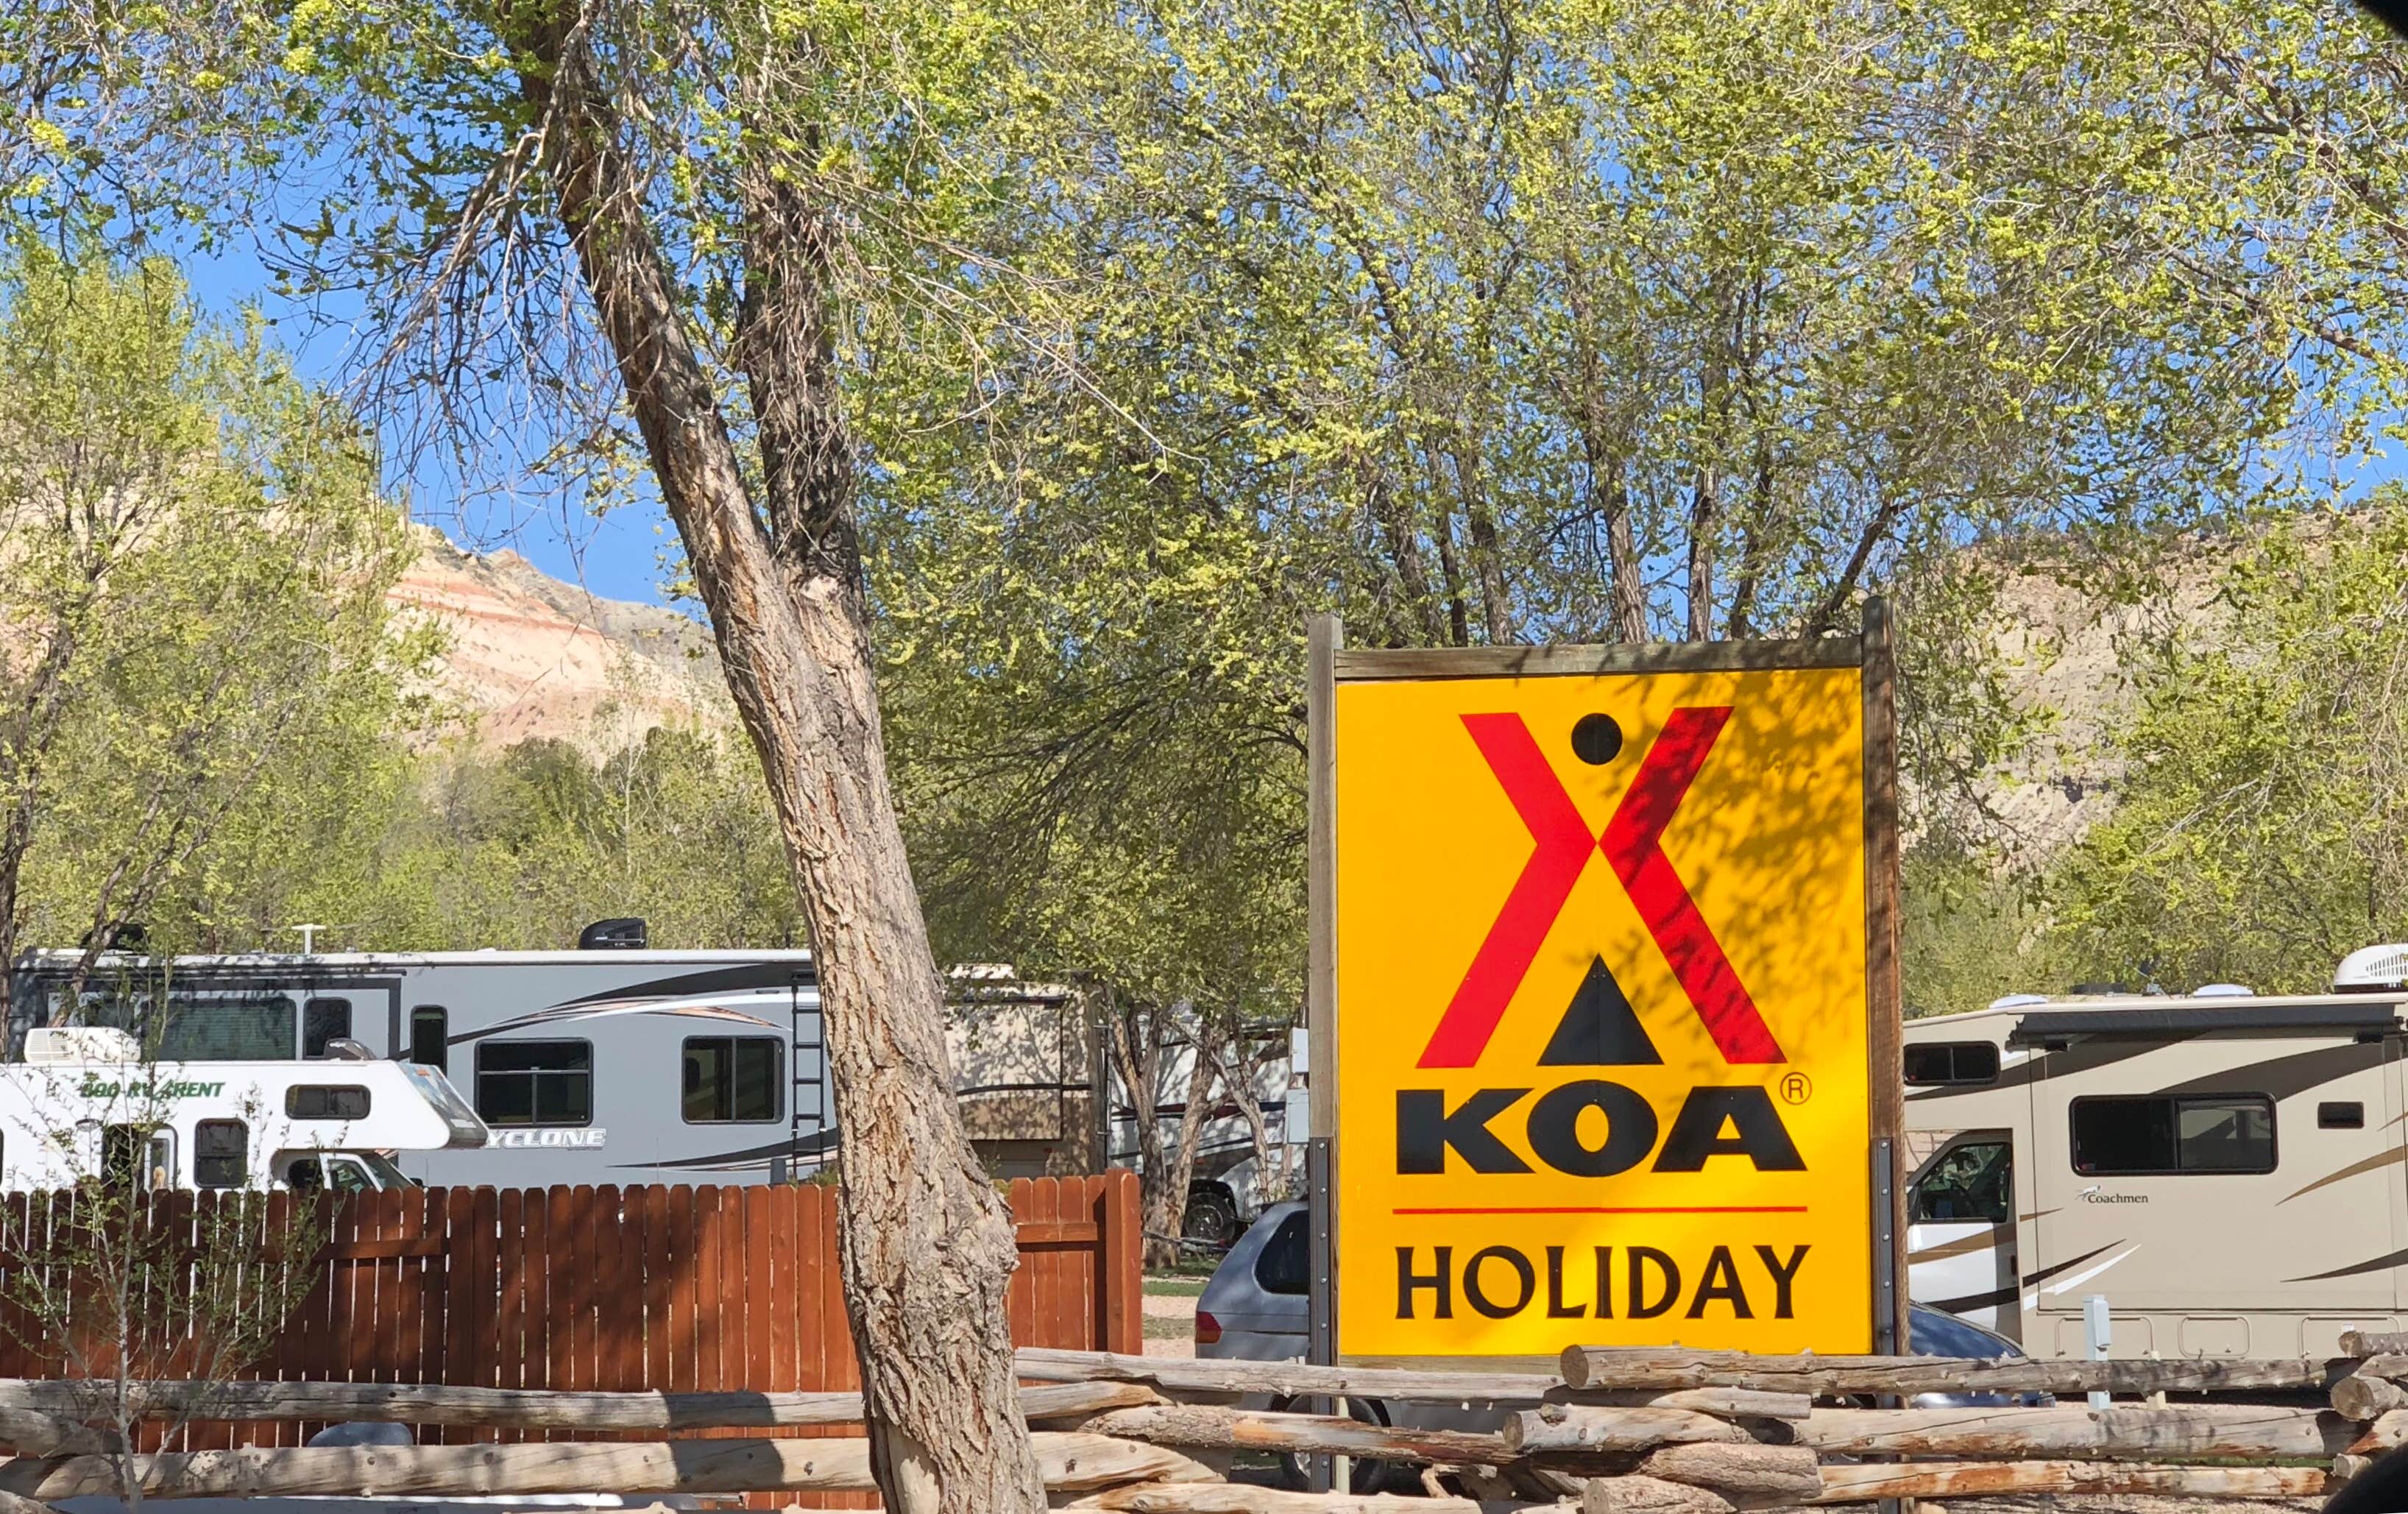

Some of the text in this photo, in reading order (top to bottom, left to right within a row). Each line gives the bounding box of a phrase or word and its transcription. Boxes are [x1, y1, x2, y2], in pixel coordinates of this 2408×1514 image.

[485, 1128, 606, 1149] YCLONE
[1396, 1079, 1807, 1175] KOA
[2088, 1193, 2148, 1203] Coachmen
[1396, 1245, 1810, 1319] HOLIDAY
